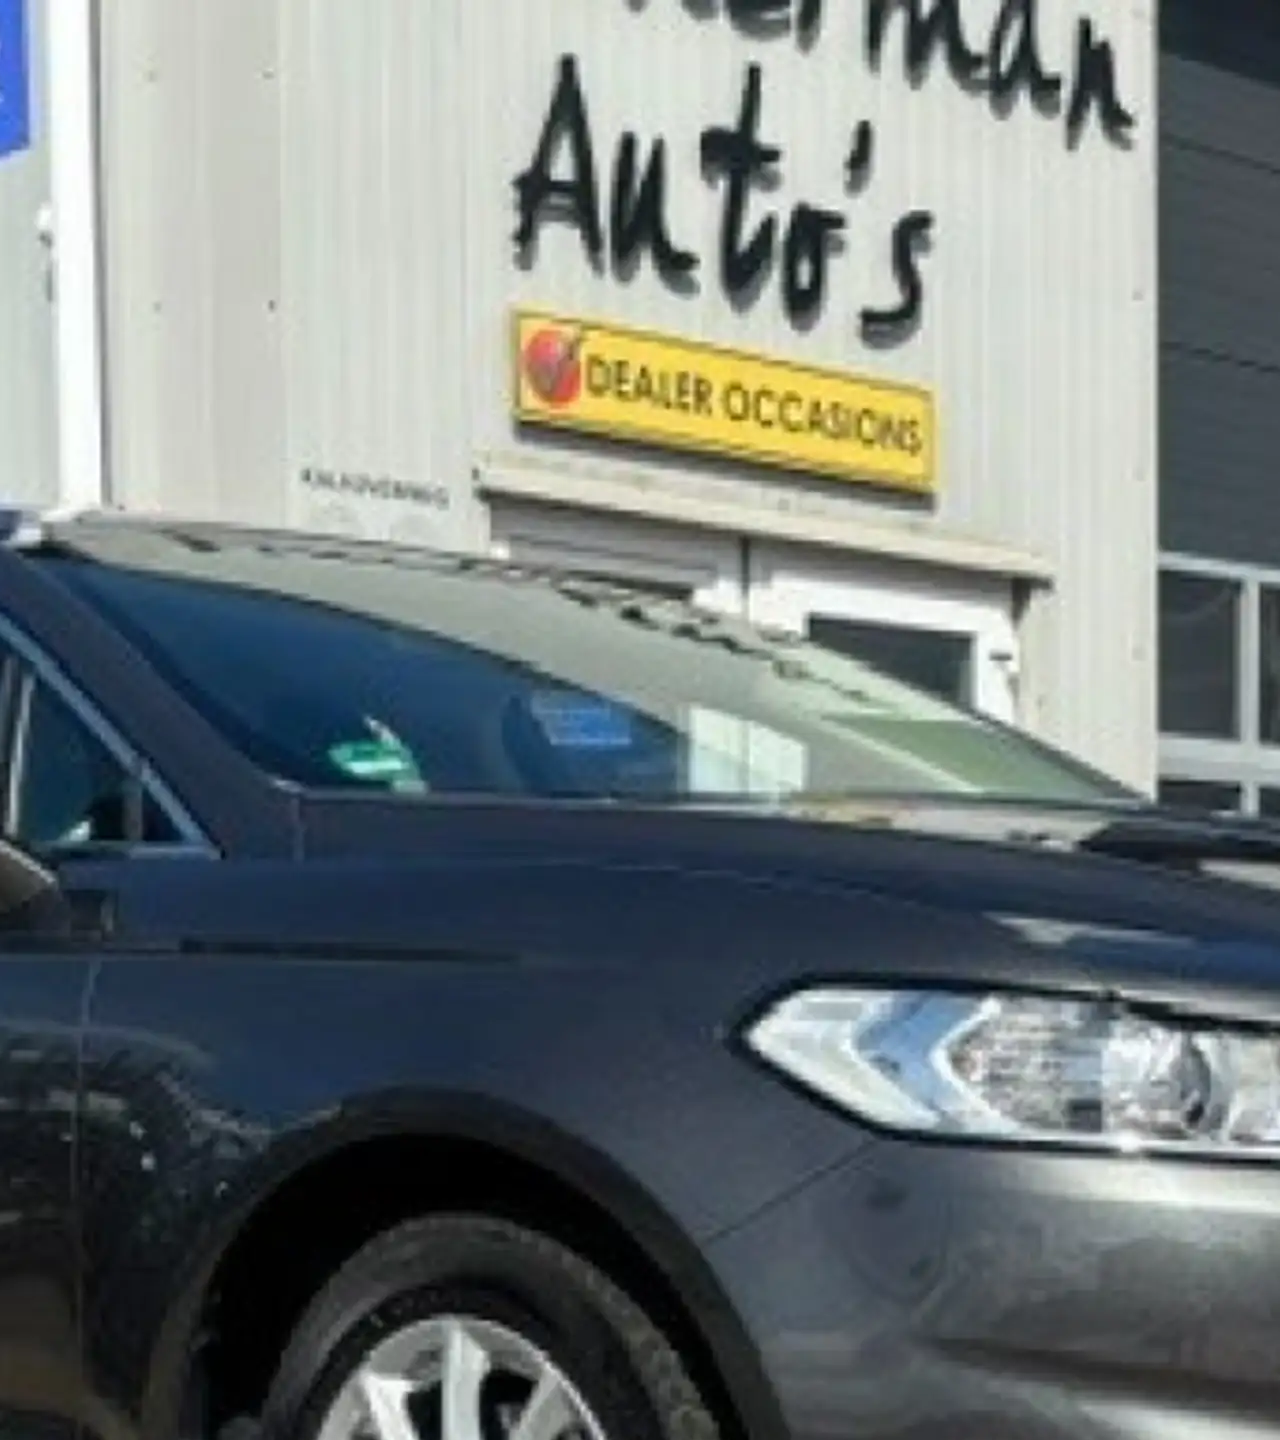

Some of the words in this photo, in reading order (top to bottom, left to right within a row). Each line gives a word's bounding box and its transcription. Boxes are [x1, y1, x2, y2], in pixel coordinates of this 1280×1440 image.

[514, 53, 933, 342] Auto's
[585, 353, 713, 418] DEALER
[721, 380, 921, 456] OCCASIONS
